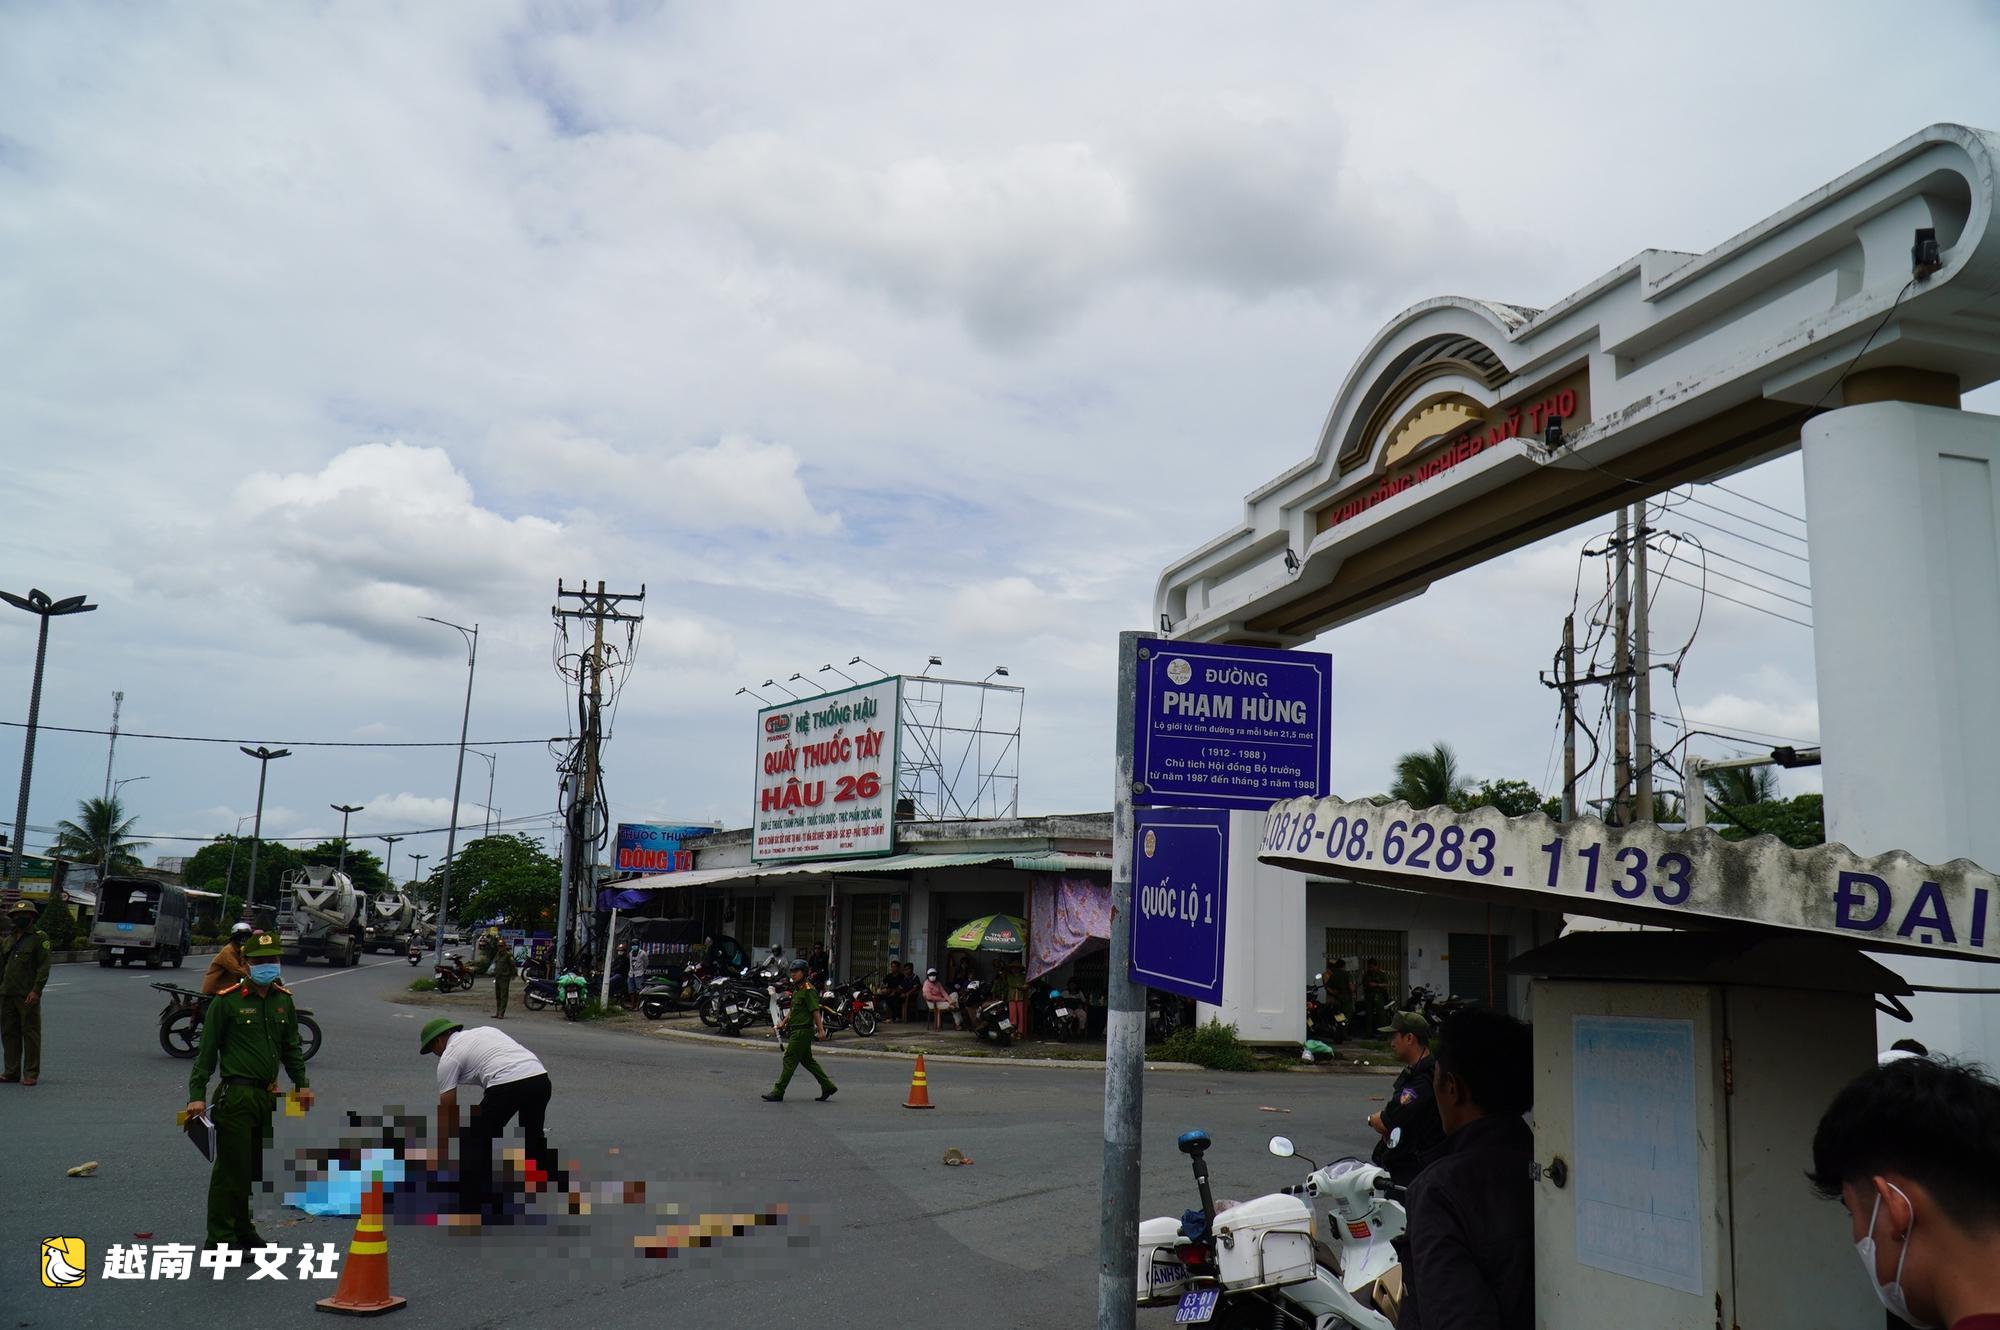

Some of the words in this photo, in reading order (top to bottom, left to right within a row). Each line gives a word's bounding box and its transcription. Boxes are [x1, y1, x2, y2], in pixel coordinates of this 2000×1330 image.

[1206, 667, 1268, 688] ĐƯỜNG
[795, 710, 810, 736] HỆ
[812, 701, 851, 730] THỐNG
[853, 696, 878, 723] HẬU
[1163, 690, 1233, 722] PHẠM
[1241, 691, 1307, 725] HÙNG
[764, 740, 798, 775] QUẦY
[803, 728, 851, 768] THUỐC
[855, 727, 885, 760] TÂY
[1280, 730, 1297, 739] 21,5
[1150, 770, 1159, 780] từ
[1162, 772, 1183, 781] năm
[1186, 773, 1208, 783] 1987
[1210, 774, 1229, 784] đến
[1231, 776, 1259, 788] tháng
[1261, 778, 1269, 787] 3
[1270, 779, 1291, 788] năm
[1294, 780, 1315, 790] 1988
[1165, 758, 1185, 768] Chủ
[1208, 761, 1225, 772] Hội
[1254, 764, 1268, 774] Bộ
[1270, 765, 1301, 777] trường
[761, 777, 824, 815] HẬU
[833, 772, 881, 803] 26
[1141, 876, 1176, 920] QUỐC
[1180, 883, 1199, 928] LỘ
[1204, 893, 1212, 924] 1
[1834, 871, 1989, 947] ĐẠI
[1175, 1306, 1212, 1322] 005.06
